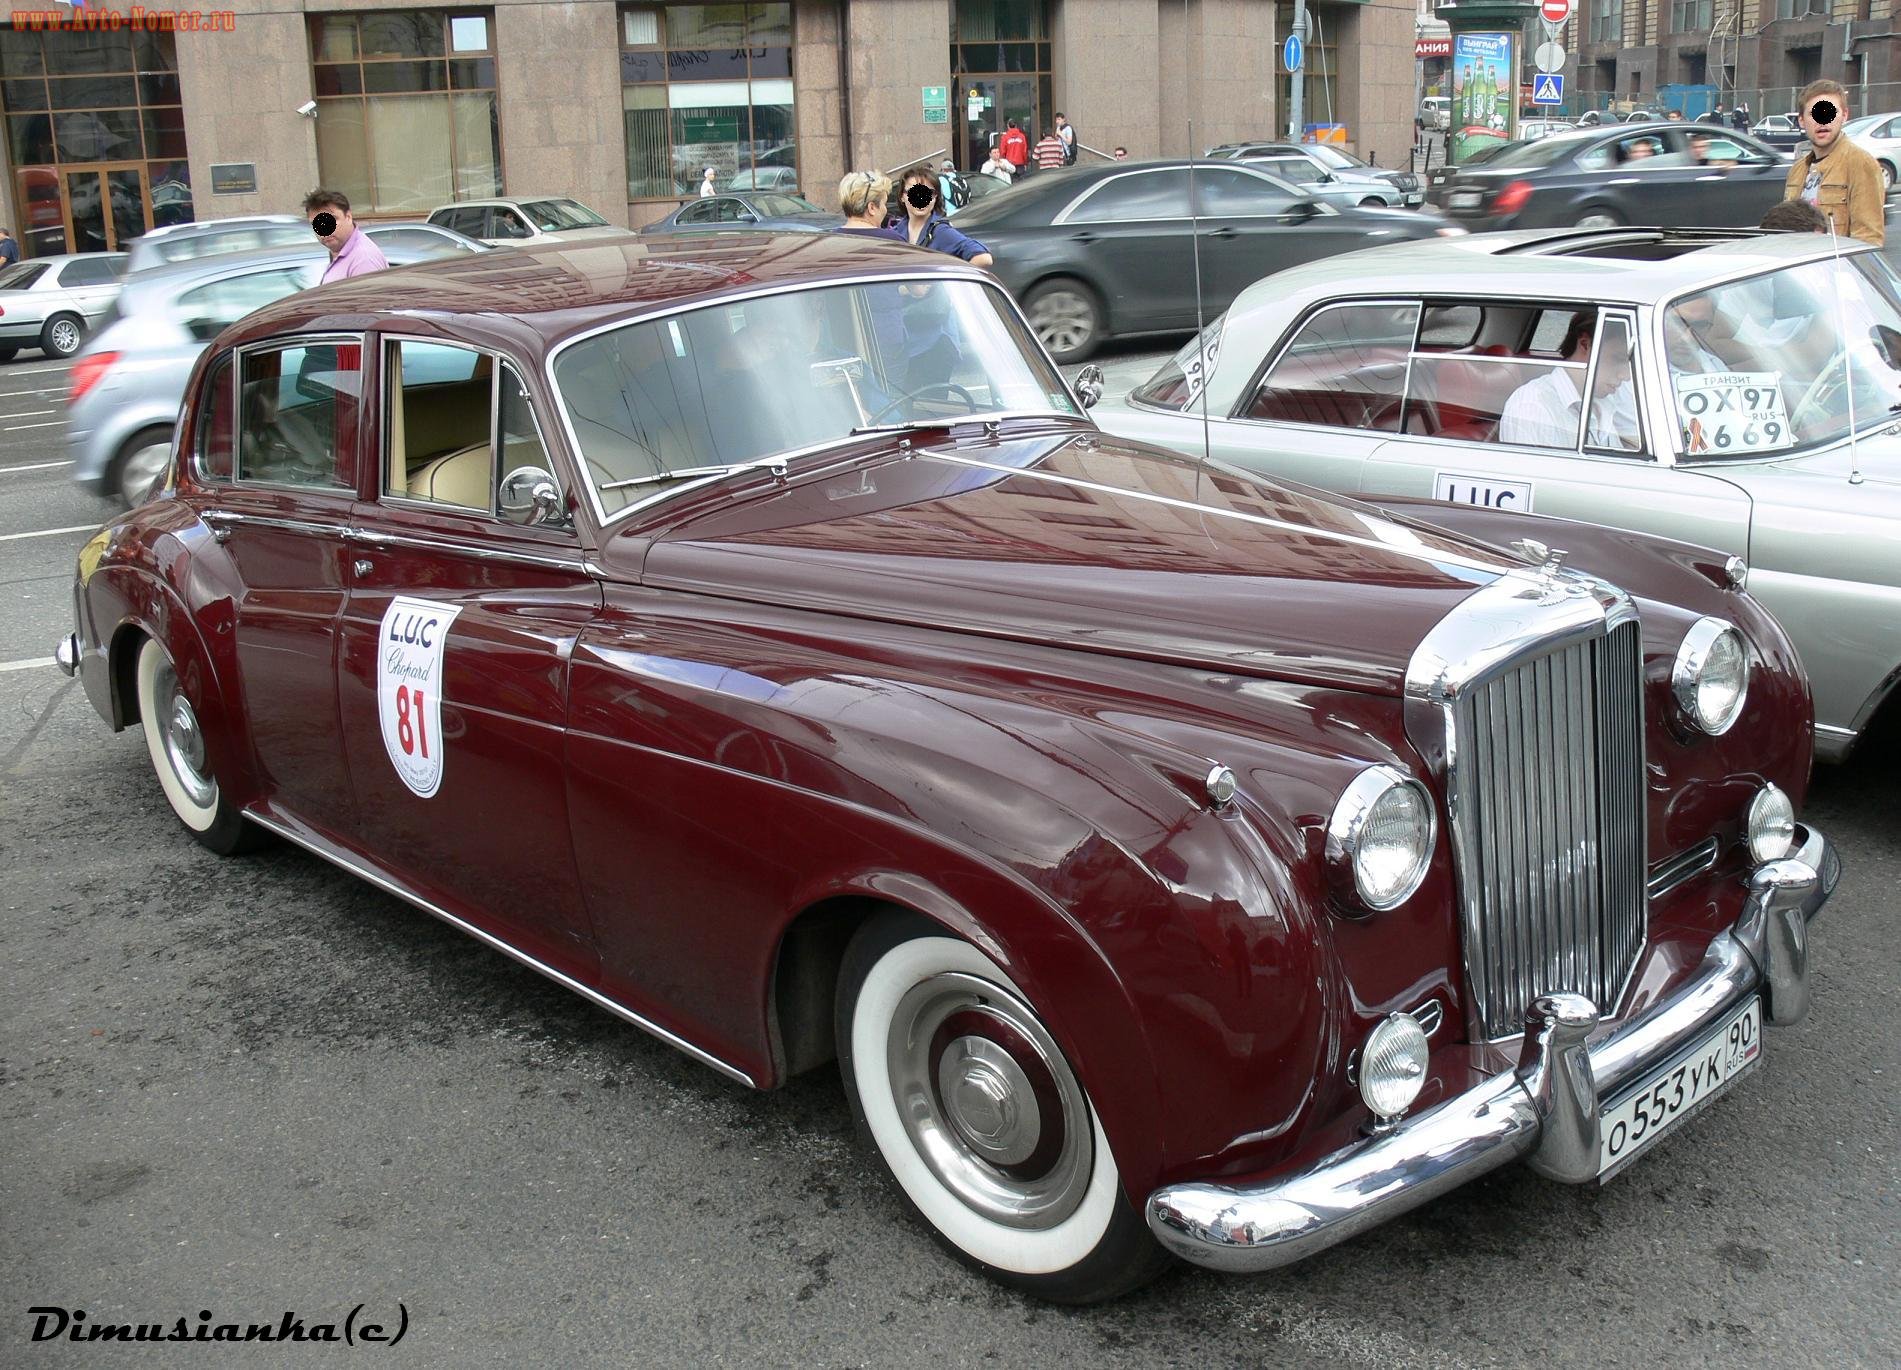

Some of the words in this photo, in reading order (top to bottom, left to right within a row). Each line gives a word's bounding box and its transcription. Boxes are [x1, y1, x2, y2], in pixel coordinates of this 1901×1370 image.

[1703, 375, 1751, 386] ТРАНЗИТ
[1743, 388, 1777, 411] 97
[1752, 411, 1776, 421] RUS
[1702, 421, 1781, 449] 669
[389, 612, 438, 649] L.U.C
[385, 645, 435, 683] Chopard
[396, 684, 429, 759] 81
[1730, 1012, 1751, 1057] 90
[1726, 1051, 1745, 1073] RUS
